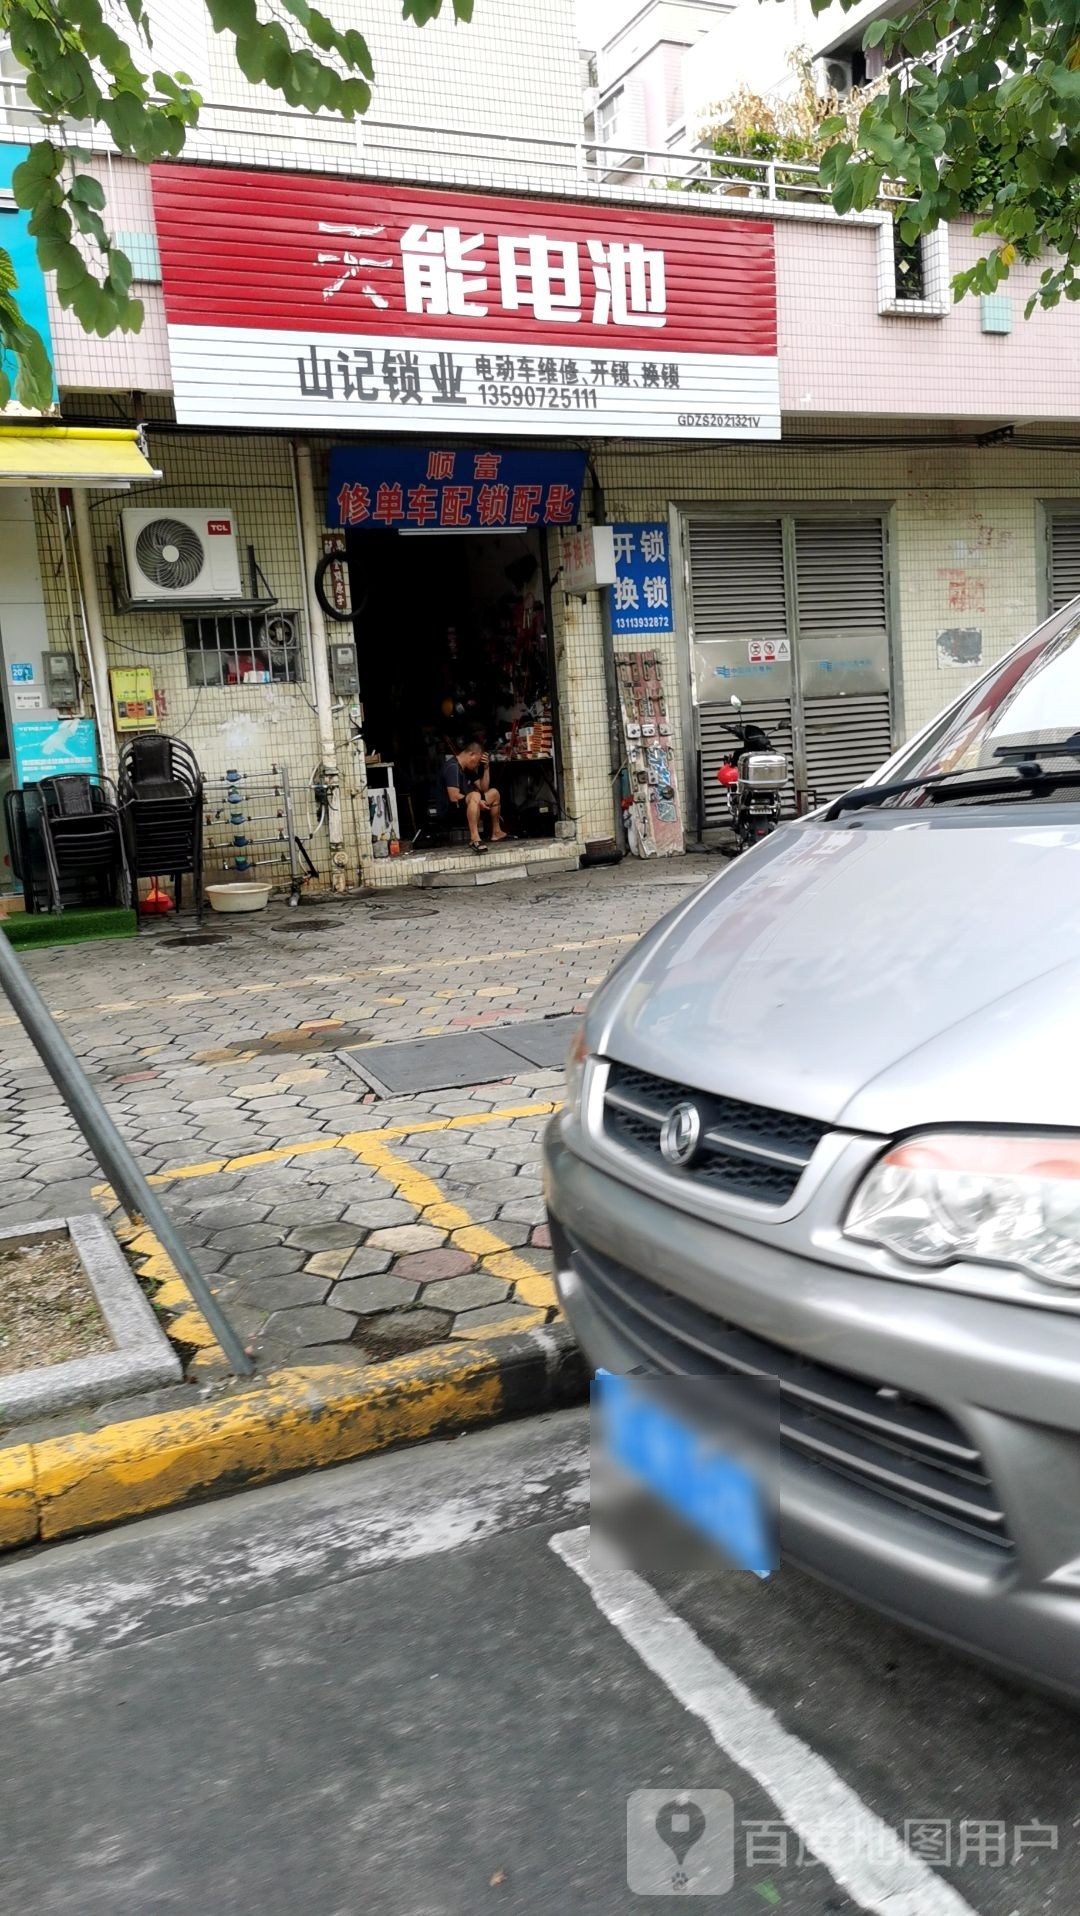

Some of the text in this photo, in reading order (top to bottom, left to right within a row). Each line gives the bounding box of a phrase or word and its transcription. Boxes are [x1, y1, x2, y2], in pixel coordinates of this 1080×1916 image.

[297, 344, 467, 405] 山记锁业
[475, 354, 680, 389] 电动车维修、开锁、换锁
[478, 383, 598, 409] 13590725111
[677, 414, 760, 428] GDZS2021321V
[426, 451, 502, 480] 顺富
[337, 482, 575, 525] 修单车配锁配匙
[210, 524, 229, 532] TCL
[613, 530, 666, 564] 开锁
[613, 575, 669, 610] 换锁
[616, 617, 669, 628] 13113932872
